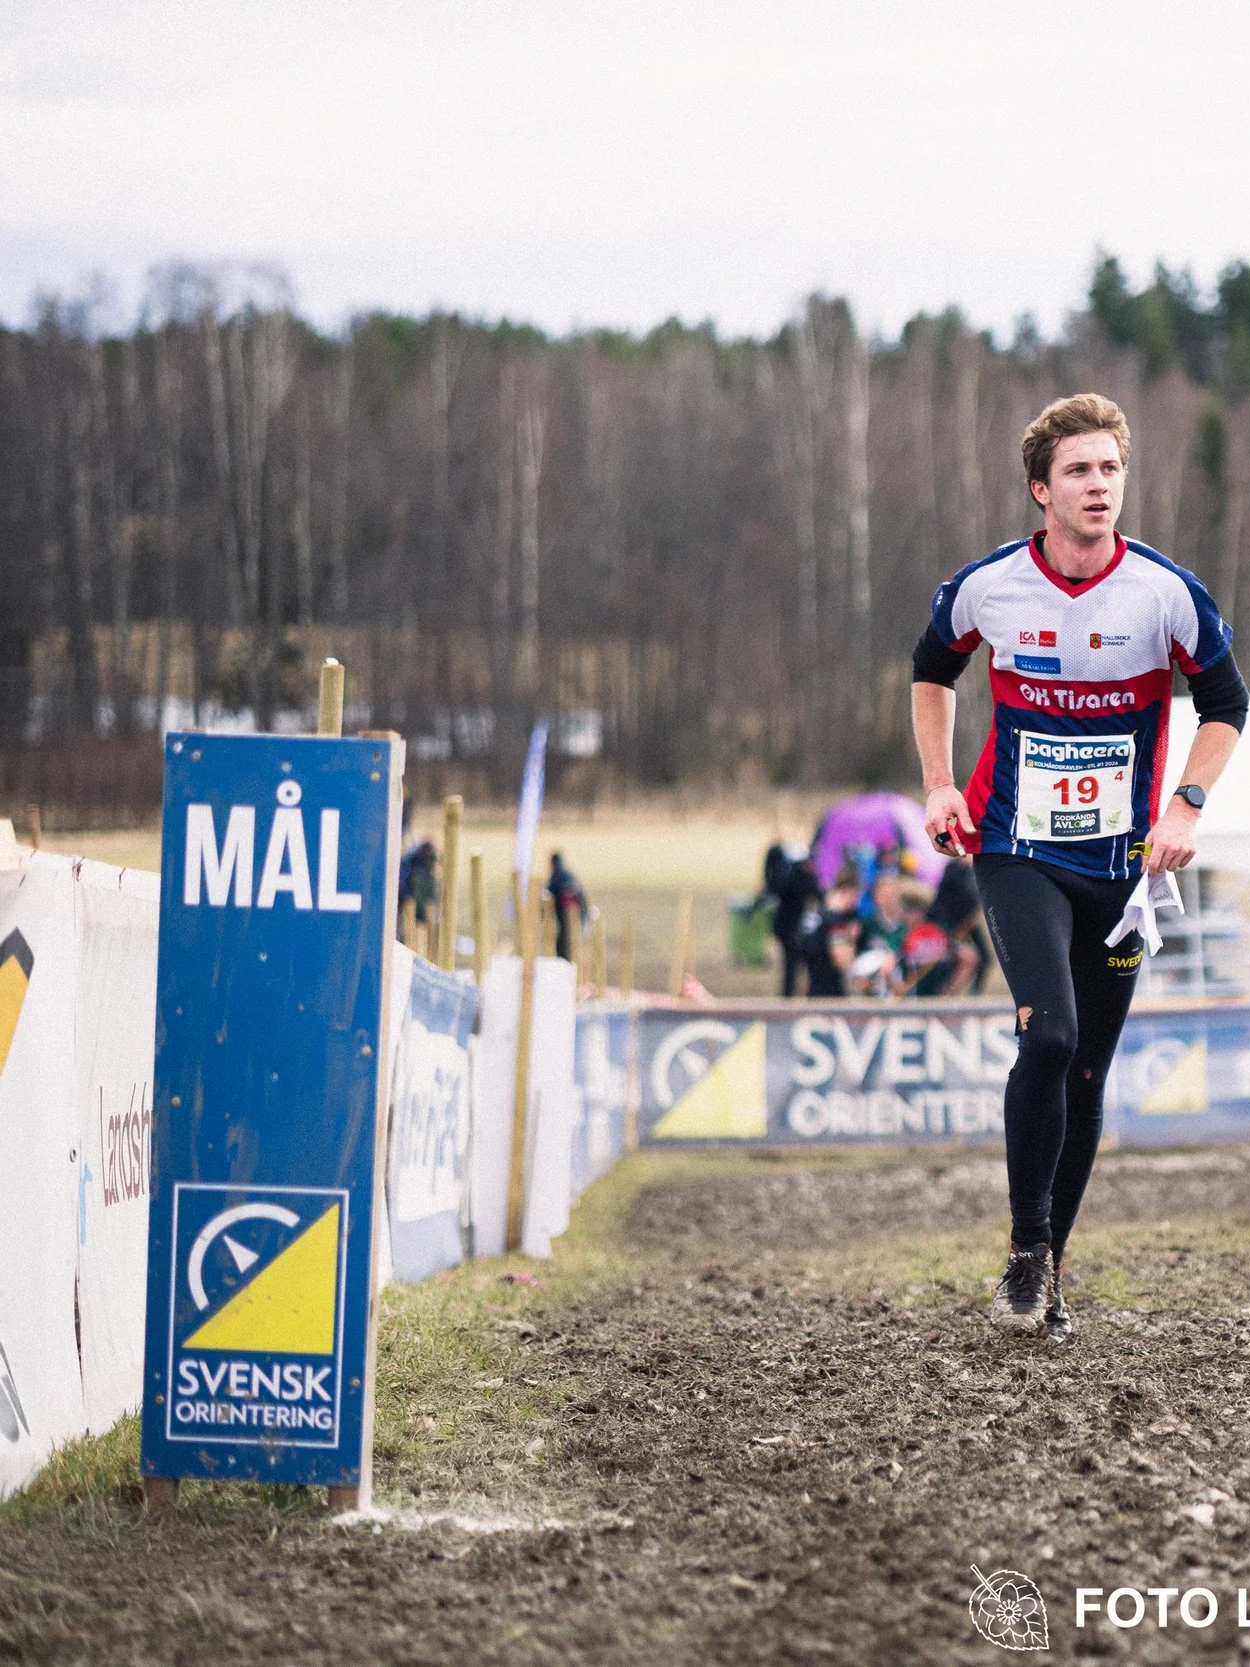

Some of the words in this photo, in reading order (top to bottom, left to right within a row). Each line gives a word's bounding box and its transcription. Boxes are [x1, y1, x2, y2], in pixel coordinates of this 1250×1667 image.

[1019, 631, 1036, 642] ICA
[1054, 689, 1135, 710] Tisaren
[1026, 739, 1129, 762] bagheera
[1053, 776, 1099, 805] 19
[1114, 770, 1124, 782] 4
[183, 779, 362, 912] MÅL
[791, 1014, 1020, 1087] SVENS
[177, 1359, 333, 1401] SVENSK
[175, 1401, 333, 1430] ORIENTERING
